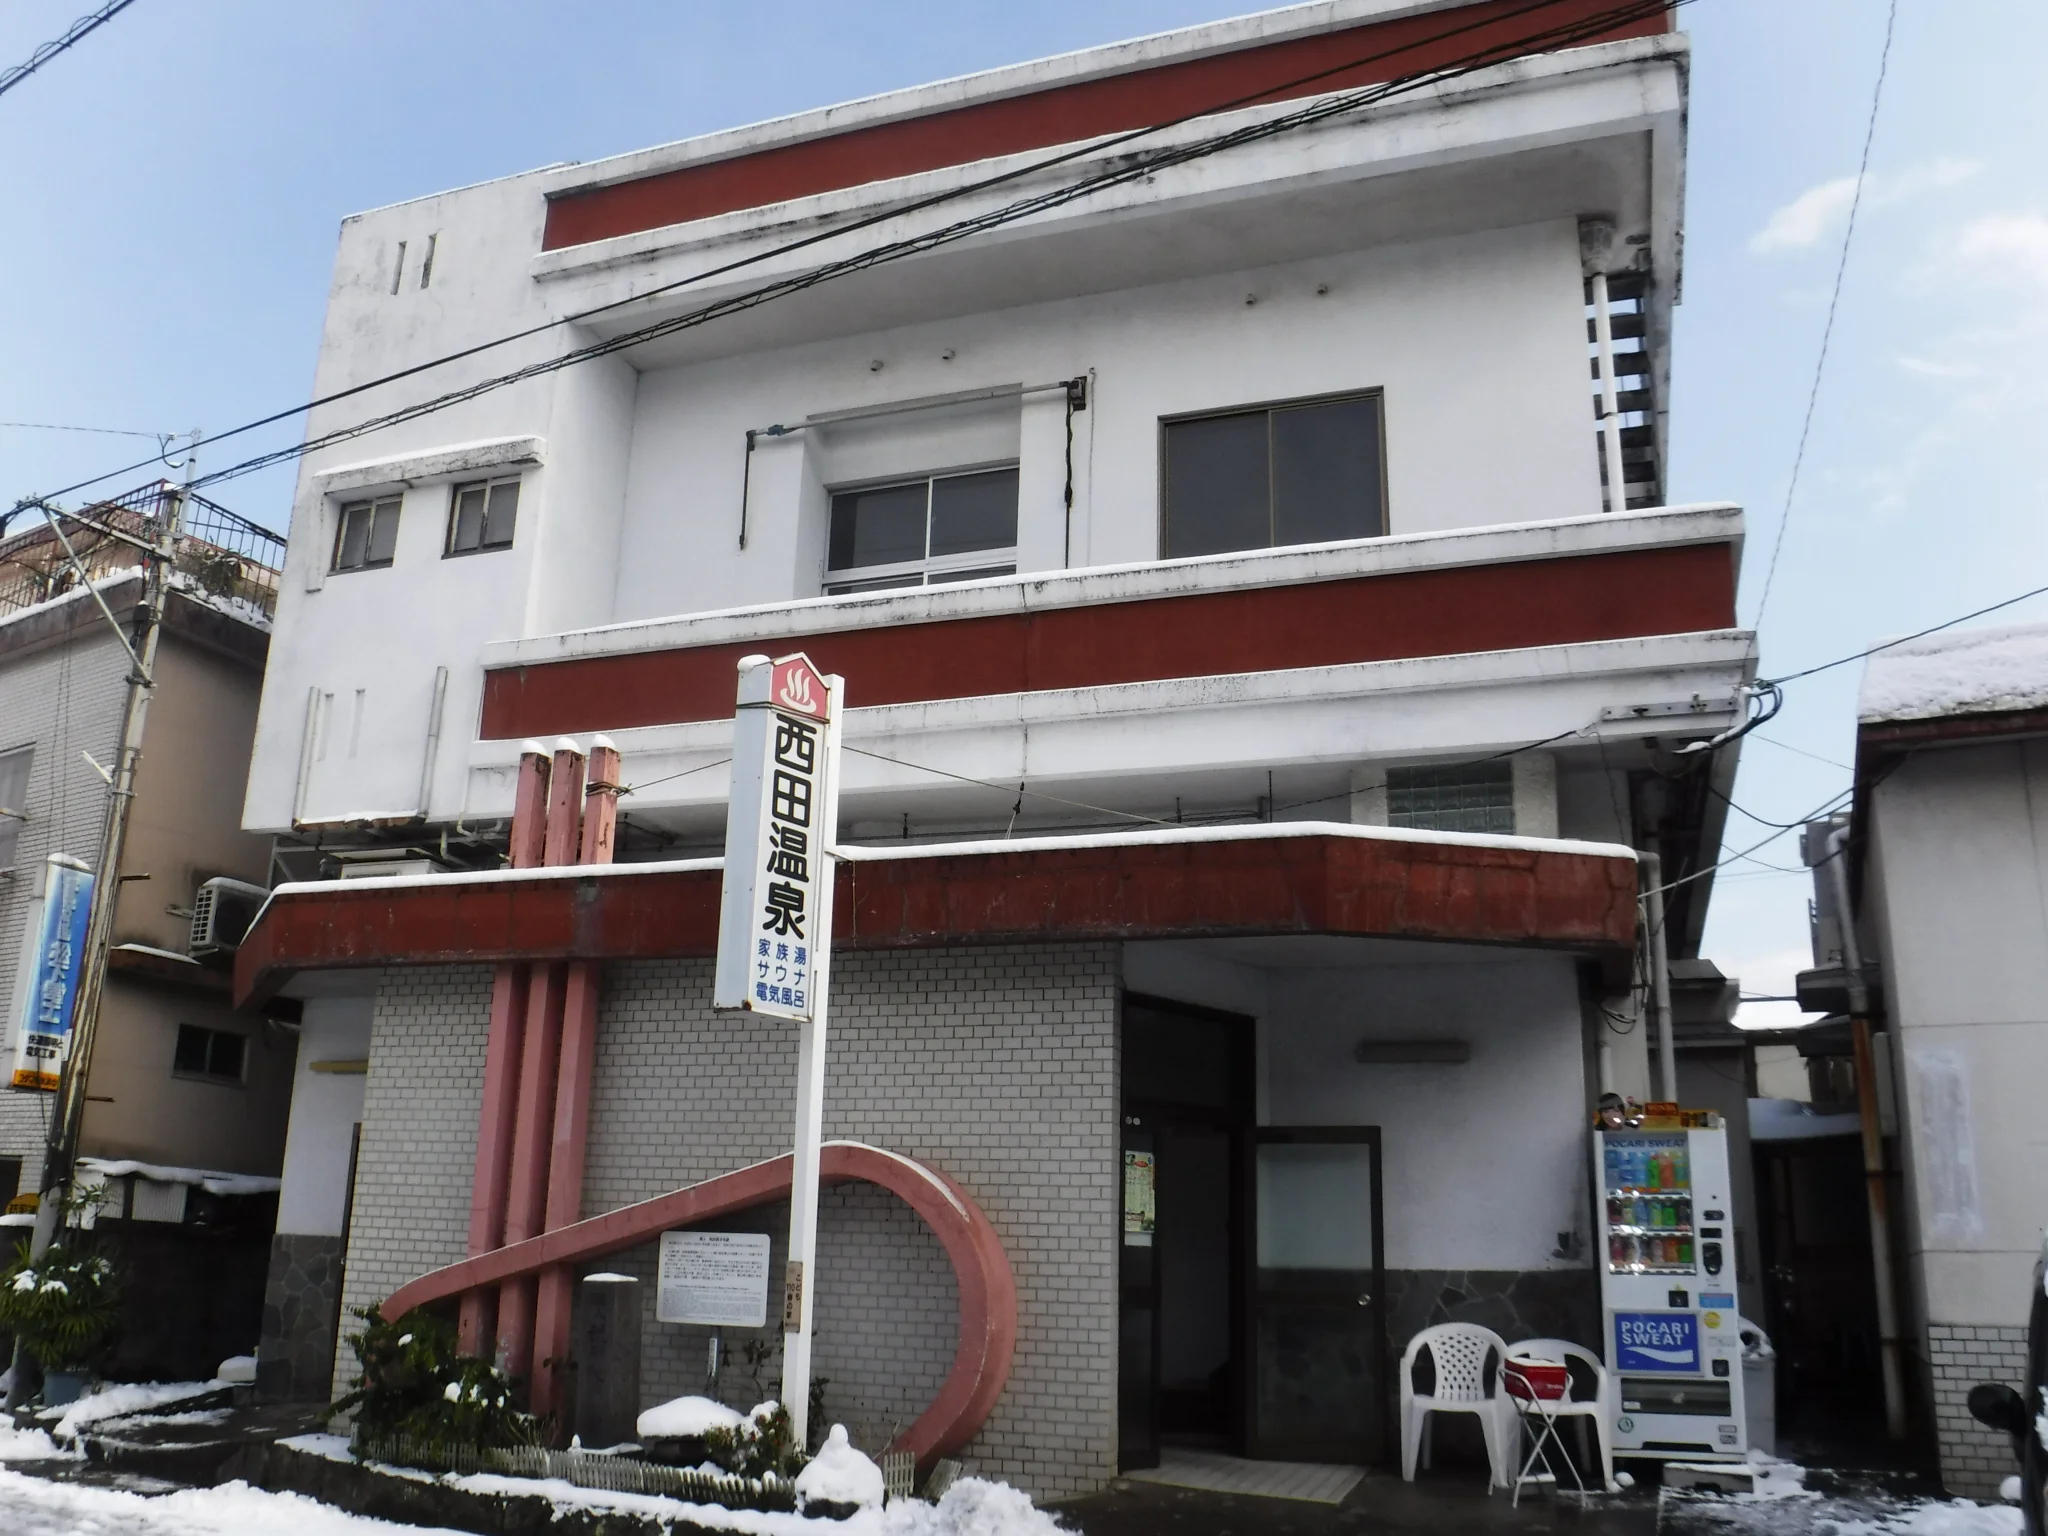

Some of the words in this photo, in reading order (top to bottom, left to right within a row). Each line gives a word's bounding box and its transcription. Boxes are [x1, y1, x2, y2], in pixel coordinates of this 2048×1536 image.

[762, 713, 818, 940] 西田温泉
[758, 938, 807, 966] 家族湯
[757, 959, 806, 986] サウナ
[755, 981, 805, 1009] 電気風呂
[1604, 1138, 1645, 1148] POCARI
[1647, 1138, 1685, 1148] SWEAT
[1620, 1321, 1690, 1335] POCARI
[1621, 1332, 1684, 1346] SWEAT
